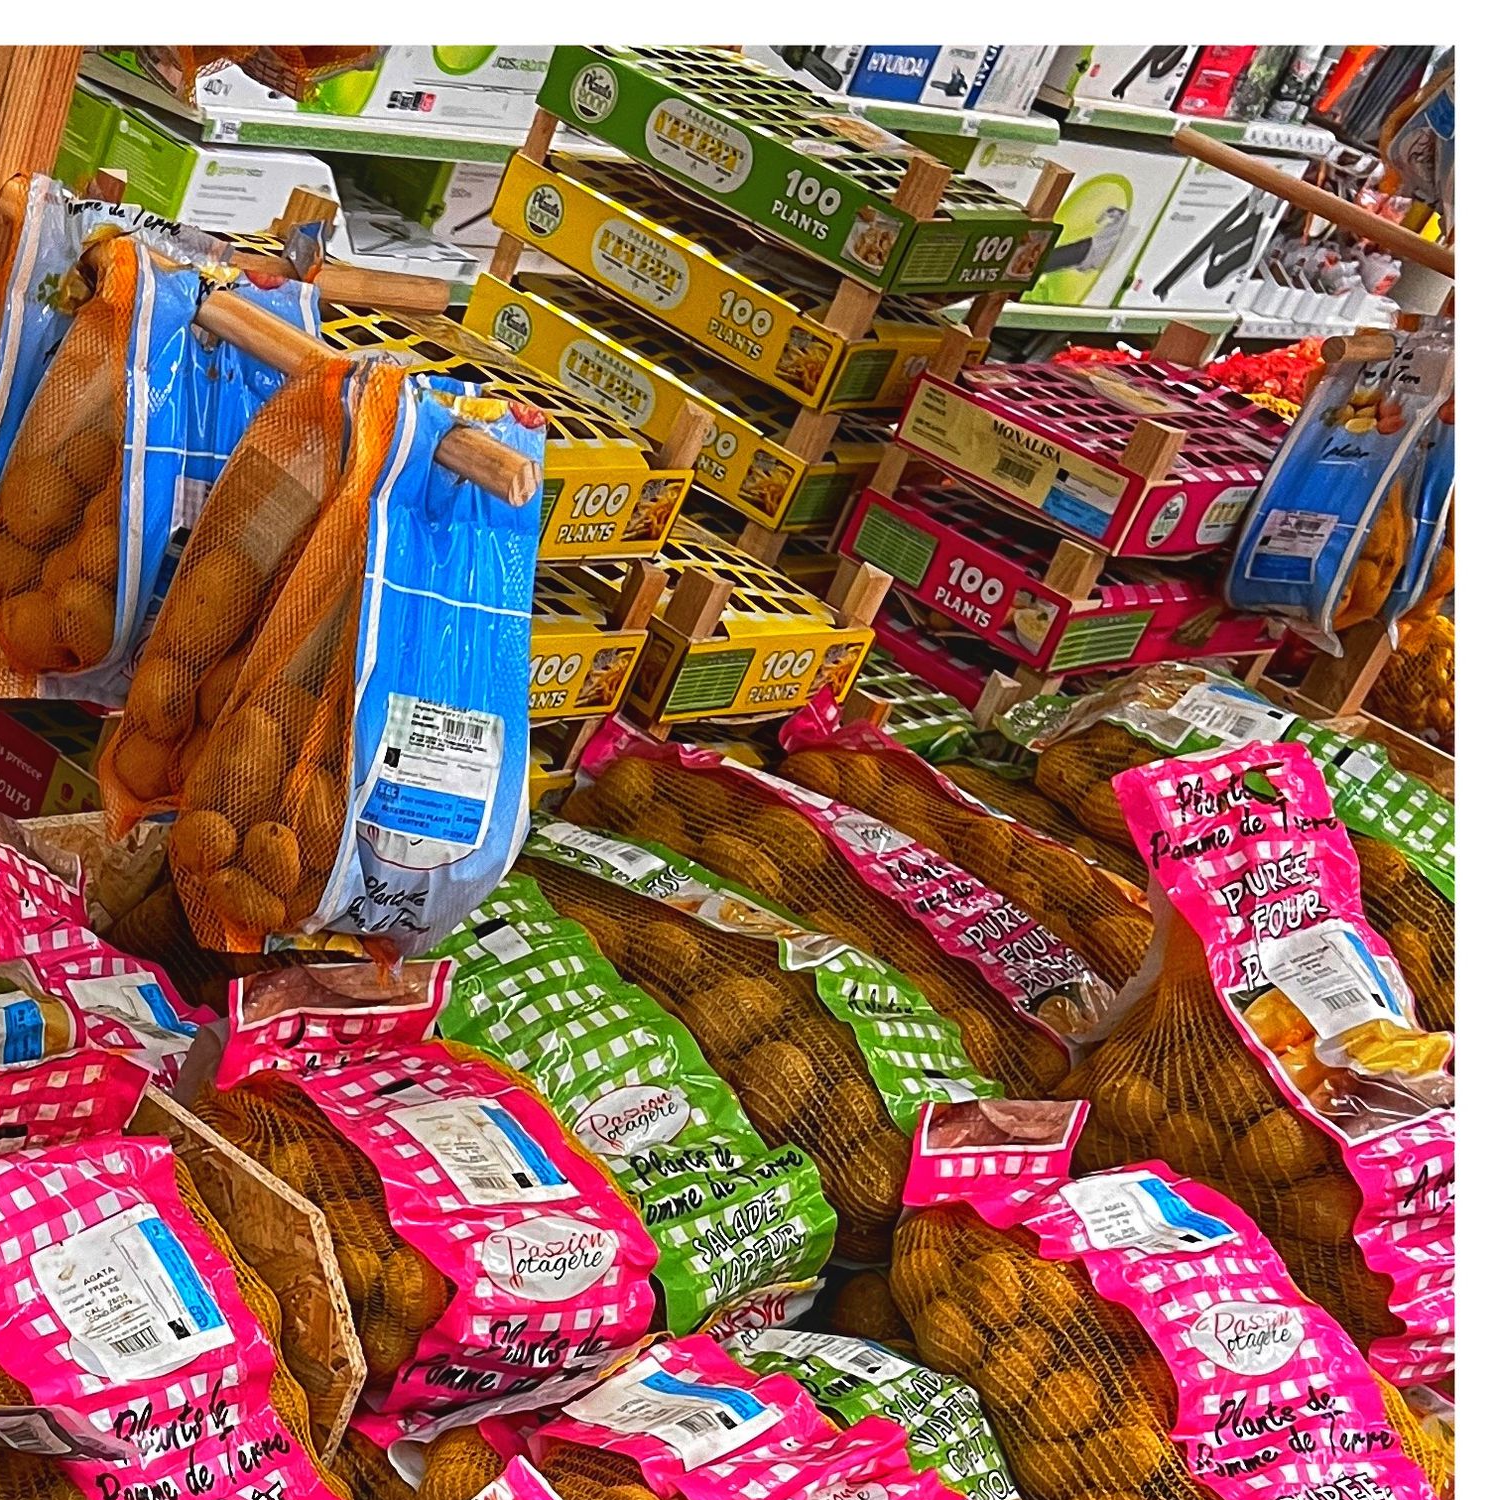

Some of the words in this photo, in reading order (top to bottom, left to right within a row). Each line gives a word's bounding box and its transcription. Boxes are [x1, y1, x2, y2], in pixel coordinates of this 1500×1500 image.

[867, 51, 930, 78] HYUNDAI
[786, 168, 841, 217] 100
[64, 197, 103, 216] omme
[108, 201, 126, 218] de
[132, 208, 181, 236] Terre
[771, 199, 829, 241] PLANTS
[972, 236, 1013, 262] 100
[958, 267, 1000, 282] PLANTS
[719, 289, 774, 336] 100
[708, 317, 764, 361] PLANTS
[700, 422, 737, 459] 00
[991, 419, 1063, 466] MONALISA
[571, 483, 631, 518] 100
[556, 522, 617, 544] PLANTS
[947, 557, 1004, 605] 100
[935, 585, 992, 629] PLANTS
[760, 649, 814, 681] 100
[528, 690, 568, 710] ANTS
[749, 683, 800, 703] PLANTS
[1149, 829, 1230, 869] Pomme
[1239, 804, 1266, 838] de
[629, 1149, 708, 1194] Plants
[713, 1141, 736, 1170] de
[711, 1171, 738, 1208] de
[737, 1152, 804, 1190] Terre
[83, 1265, 116, 1287] AGATA
[88, 1275, 122, 1294] FRANCE
[489, 1320, 571, 1367] Plants
[574, 1320, 605, 1356] de
[403, 1355, 499, 1398] Pomme
[1213, 1398, 1296, 1446] Plants
[1288, 1428, 1318, 1456] de
[1321, 1411, 1396, 1452] Terre
[185, 1441, 215, 1491] de
[214, 1432, 290, 1486] Terre
